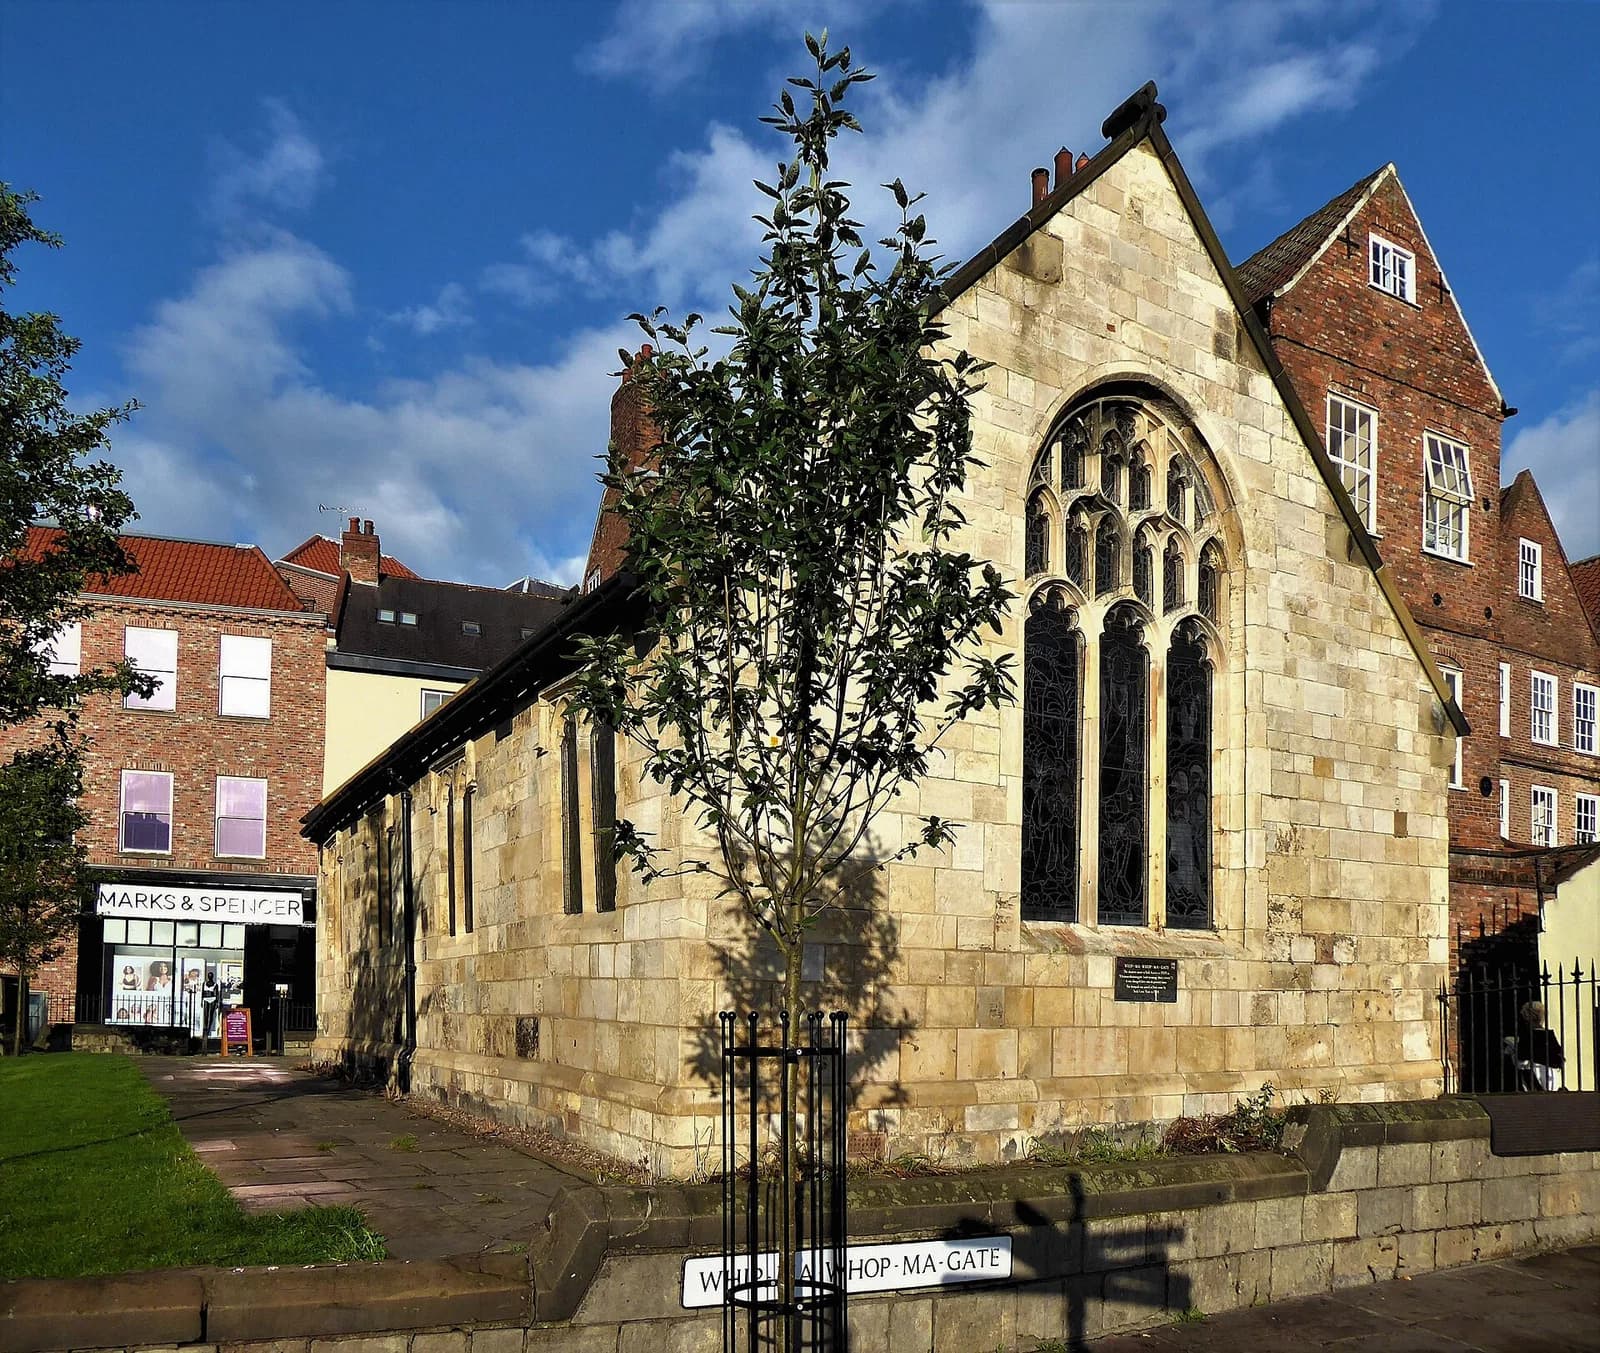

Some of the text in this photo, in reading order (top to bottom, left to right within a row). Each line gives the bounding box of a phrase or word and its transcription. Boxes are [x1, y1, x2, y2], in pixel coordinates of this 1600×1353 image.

[99, 891, 301, 917] MARKS & SPENCER
